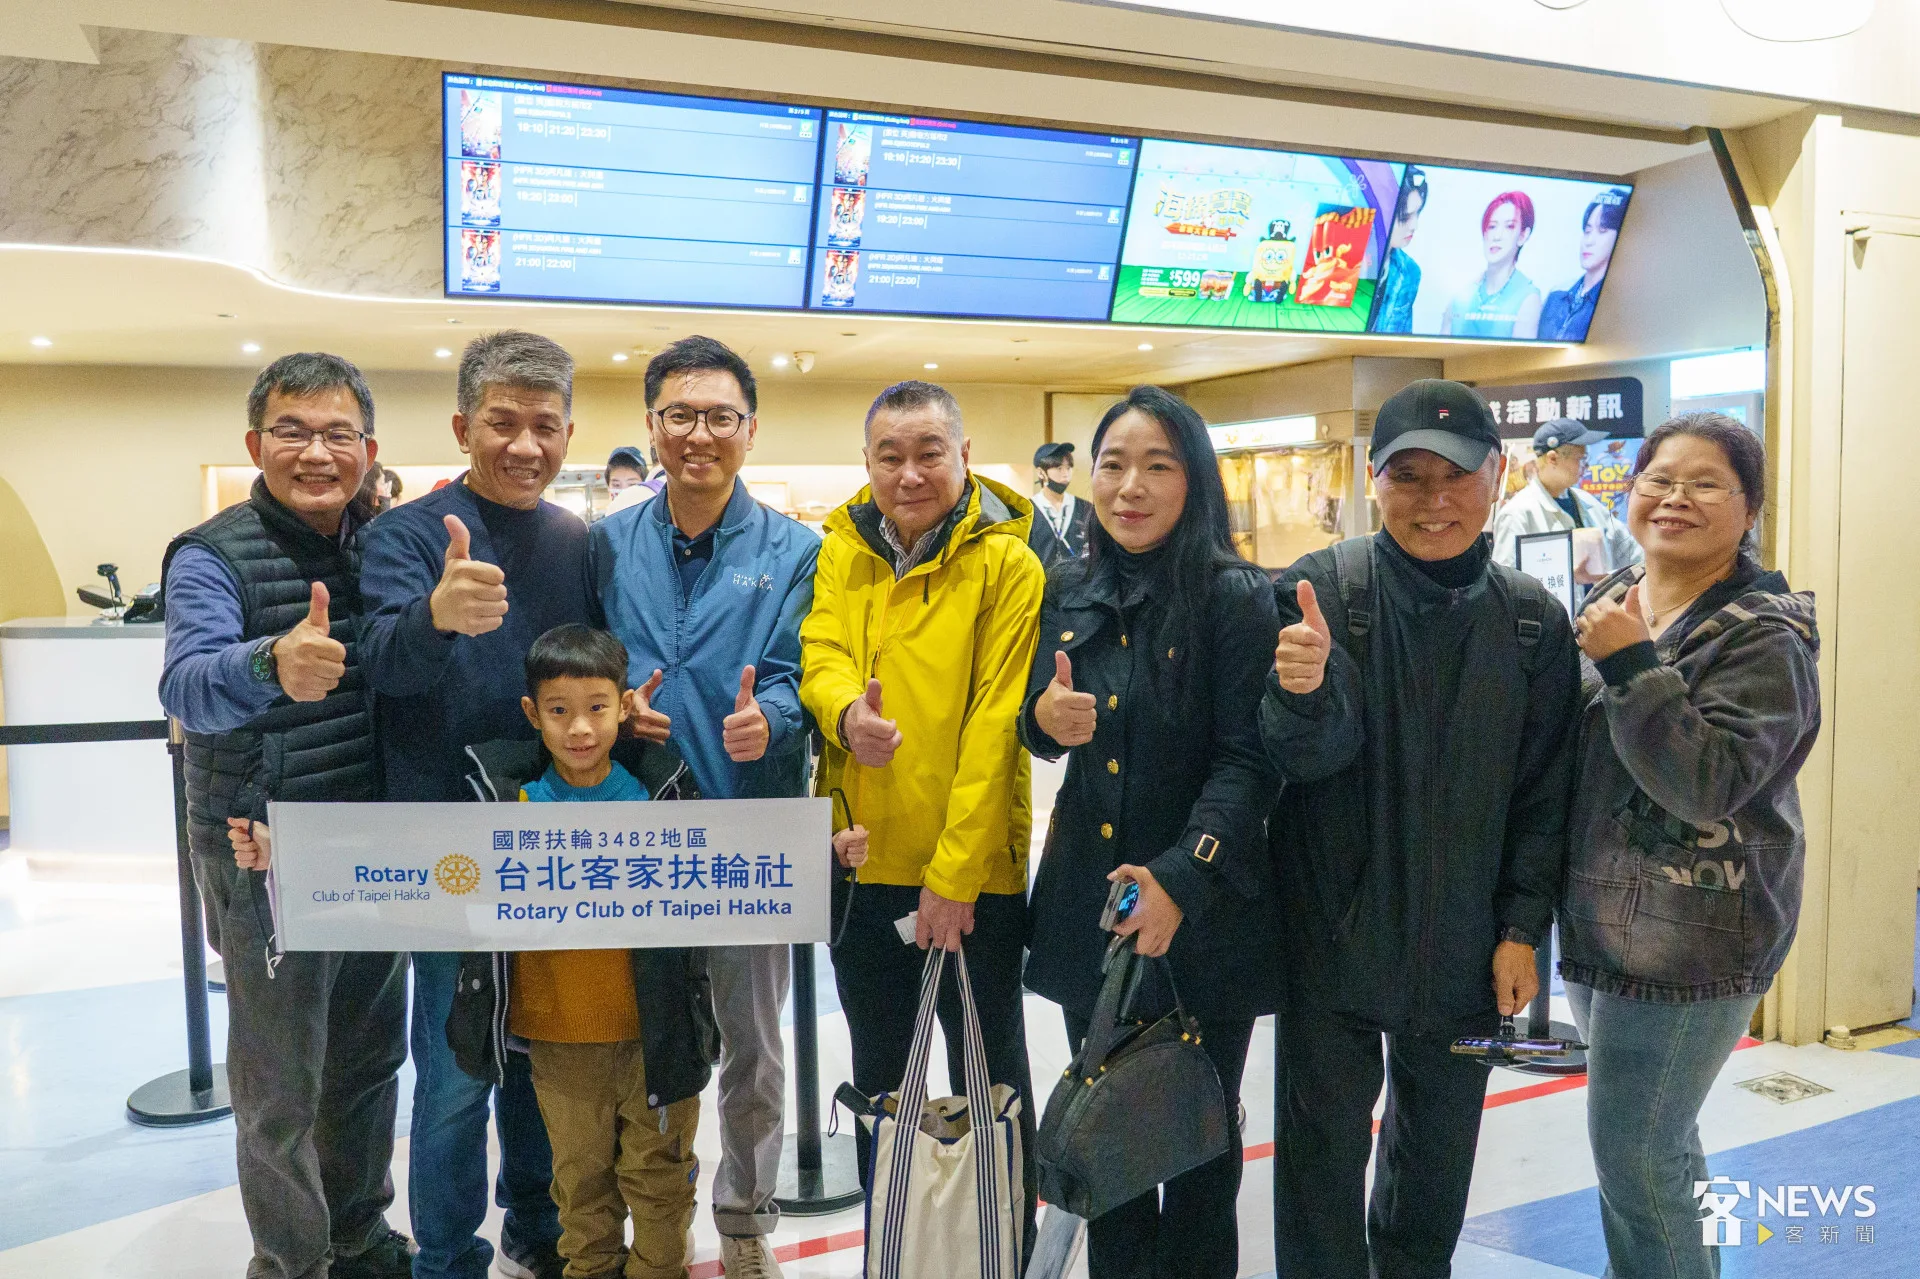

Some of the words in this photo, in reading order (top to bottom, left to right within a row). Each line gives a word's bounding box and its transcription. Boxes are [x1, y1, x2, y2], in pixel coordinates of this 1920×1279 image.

[549, 124, 575, 136] 21:20
[909, 154, 931, 164] 21:20
[935, 156, 958, 166] 23:30
[548, 193, 573, 203] 23:00
[902, 216, 924, 225] 23:00
[514, 257, 541, 267] 21:00
[546, 259, 572, 268] 22:00
[868, 275, 890, 284] 21:00
[895, 276, 917, 285] 22:00
[1169, 269, 1200, 287] $599
[1588, 464, 1630, 482] TOY
[1600, 492, 1615, 510] 5
[732, 577, 773, 590] HAKKA
[1547, 574, 1565, 589] 換餐
[493, 828, 707, 850] 國際扶輪3482地區
[355, 865, 429, 886] Rotary
[495, 852, 793, 892] 台北客家扶輪社
[312, 890, 340, 902] Club
[342, 889, 355, 901] of
[357, 889, 391, 904] Taipei
[394, 889, 430, 901] Hakka
[497, 903, 569, 923] Rotary
[575, 901, 625, 918] Club
[632, 900, 652, 917] of
[659, 900, 721, 920] Taipei
[728, 899, 792, 916] Hakka
